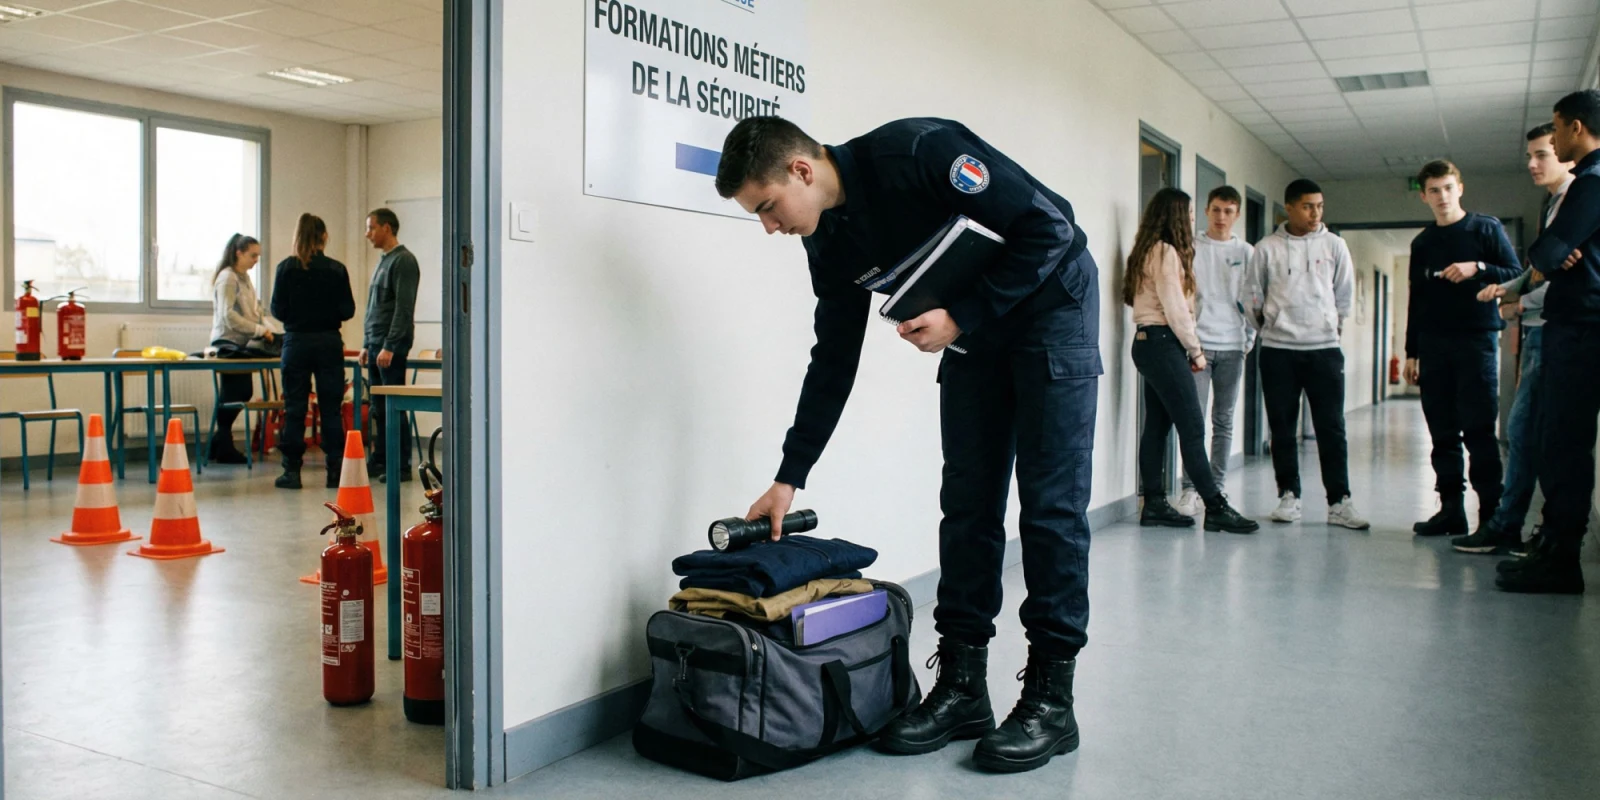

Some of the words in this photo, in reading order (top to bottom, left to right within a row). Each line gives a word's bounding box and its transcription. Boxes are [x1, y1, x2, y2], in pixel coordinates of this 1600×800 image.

[594, 0, 728, 68] FORMATIONS
[735, 42, 805, 94] MÉTIERS
[632, 60, 659, 100] DE
[666, 71, 691, 109] LA
